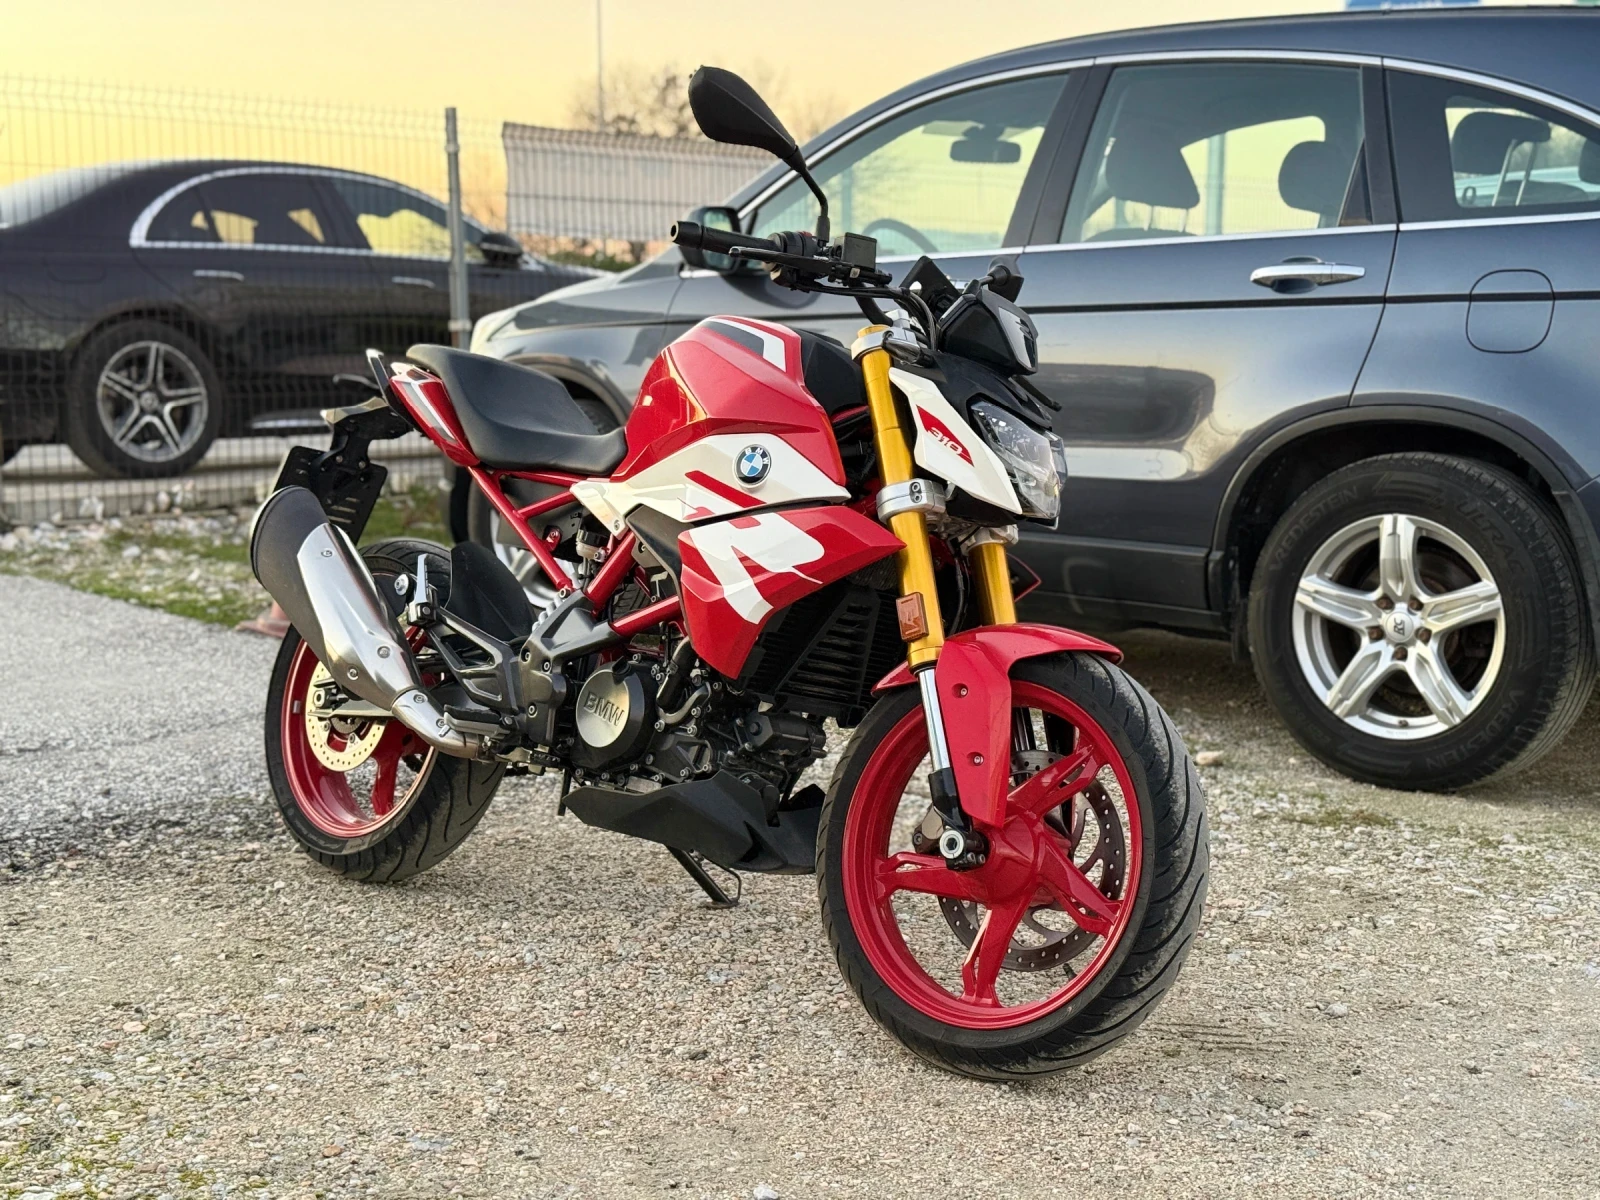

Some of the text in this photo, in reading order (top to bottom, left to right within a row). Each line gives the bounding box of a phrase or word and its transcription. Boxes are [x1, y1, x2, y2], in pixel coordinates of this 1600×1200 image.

[928, 427, 963, 455] 310
[1268, 486, 1358, 572] VREDESTEIN
[583, 691, 625, 727] BMW
